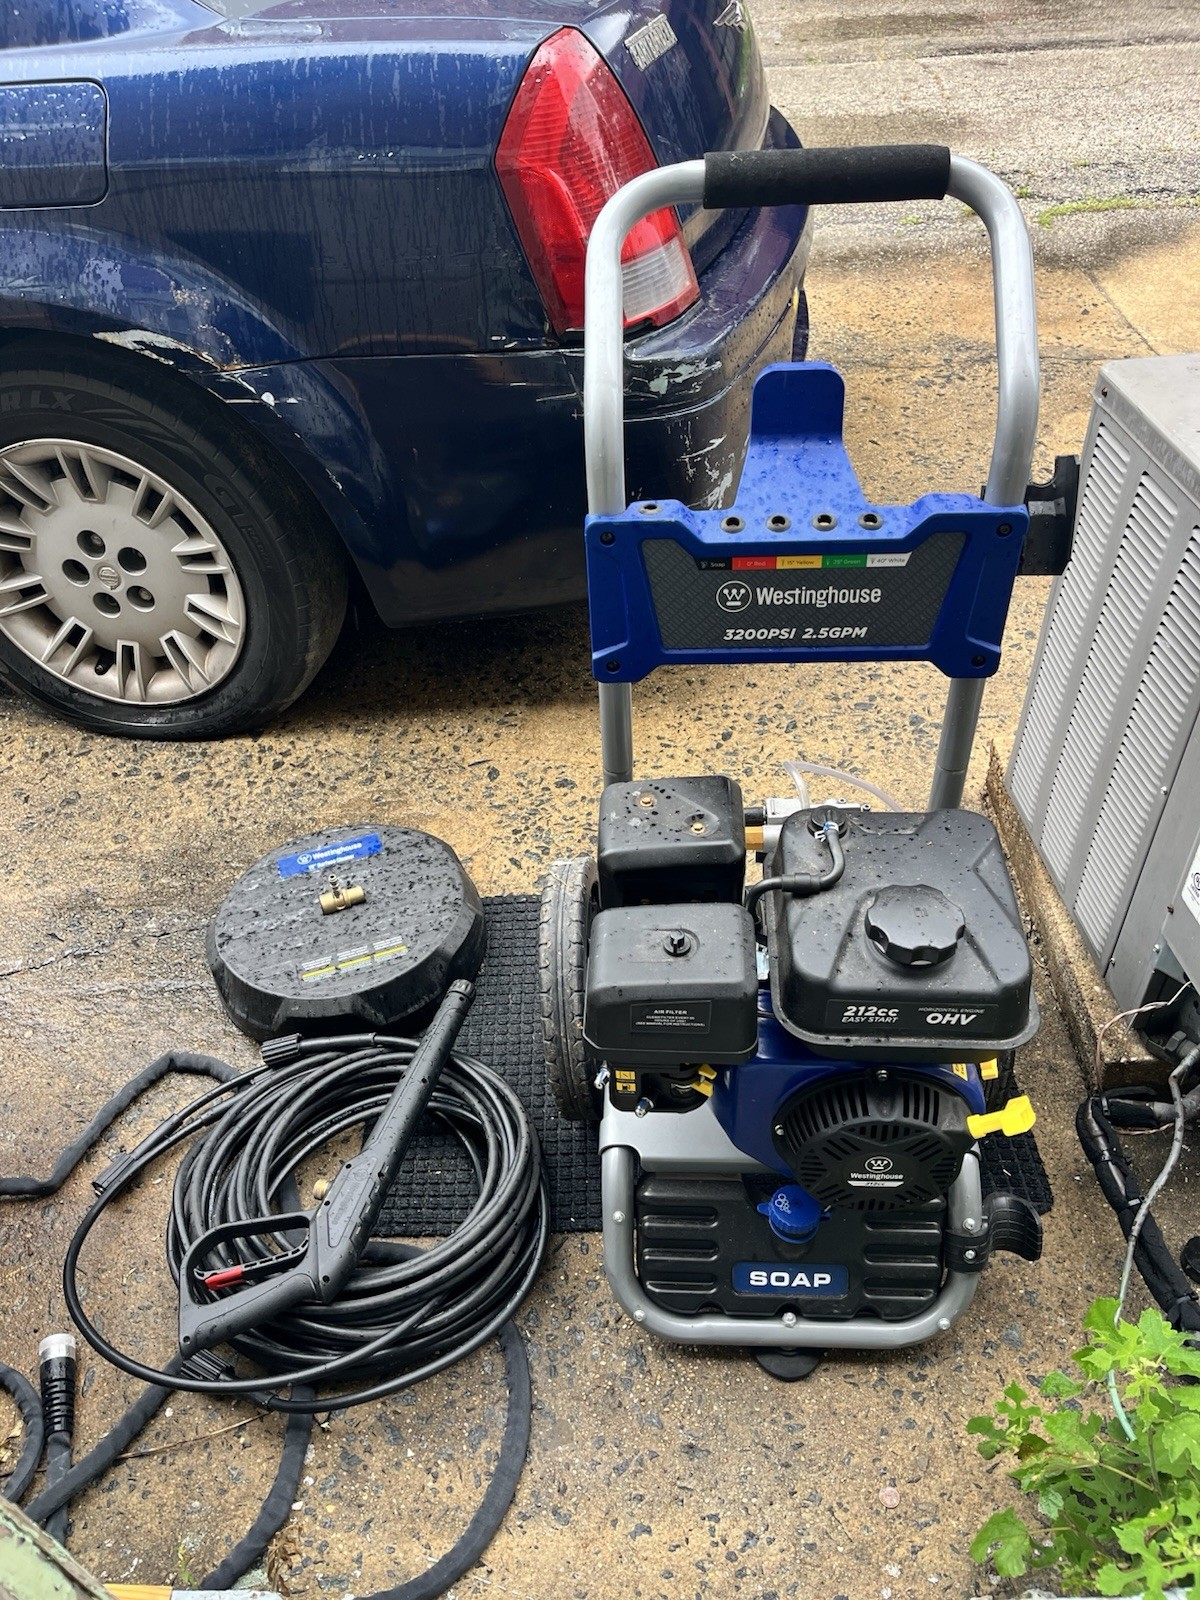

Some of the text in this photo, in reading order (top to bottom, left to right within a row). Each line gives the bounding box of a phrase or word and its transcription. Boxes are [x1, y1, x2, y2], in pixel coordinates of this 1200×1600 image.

[709, 561, 726, 569] Soap
[843, 558, 861, 566] Green
[887, 556, 906, 564] White
[755, 586, 882, 608] Westinghouse
[723, 626, 869, 641] 3200PSI 2.5GPM
[312, 842, 363, 860] Westinghouse
[843, 1005, 900, 1017] 212cc
[841, 1016, 899, 1024] EASY START
[925, 1012, 977, 1026] OHV
[850, 1172, 904, 1181] Westinghouse
[749, 1270, 832, 1288] SOAP
